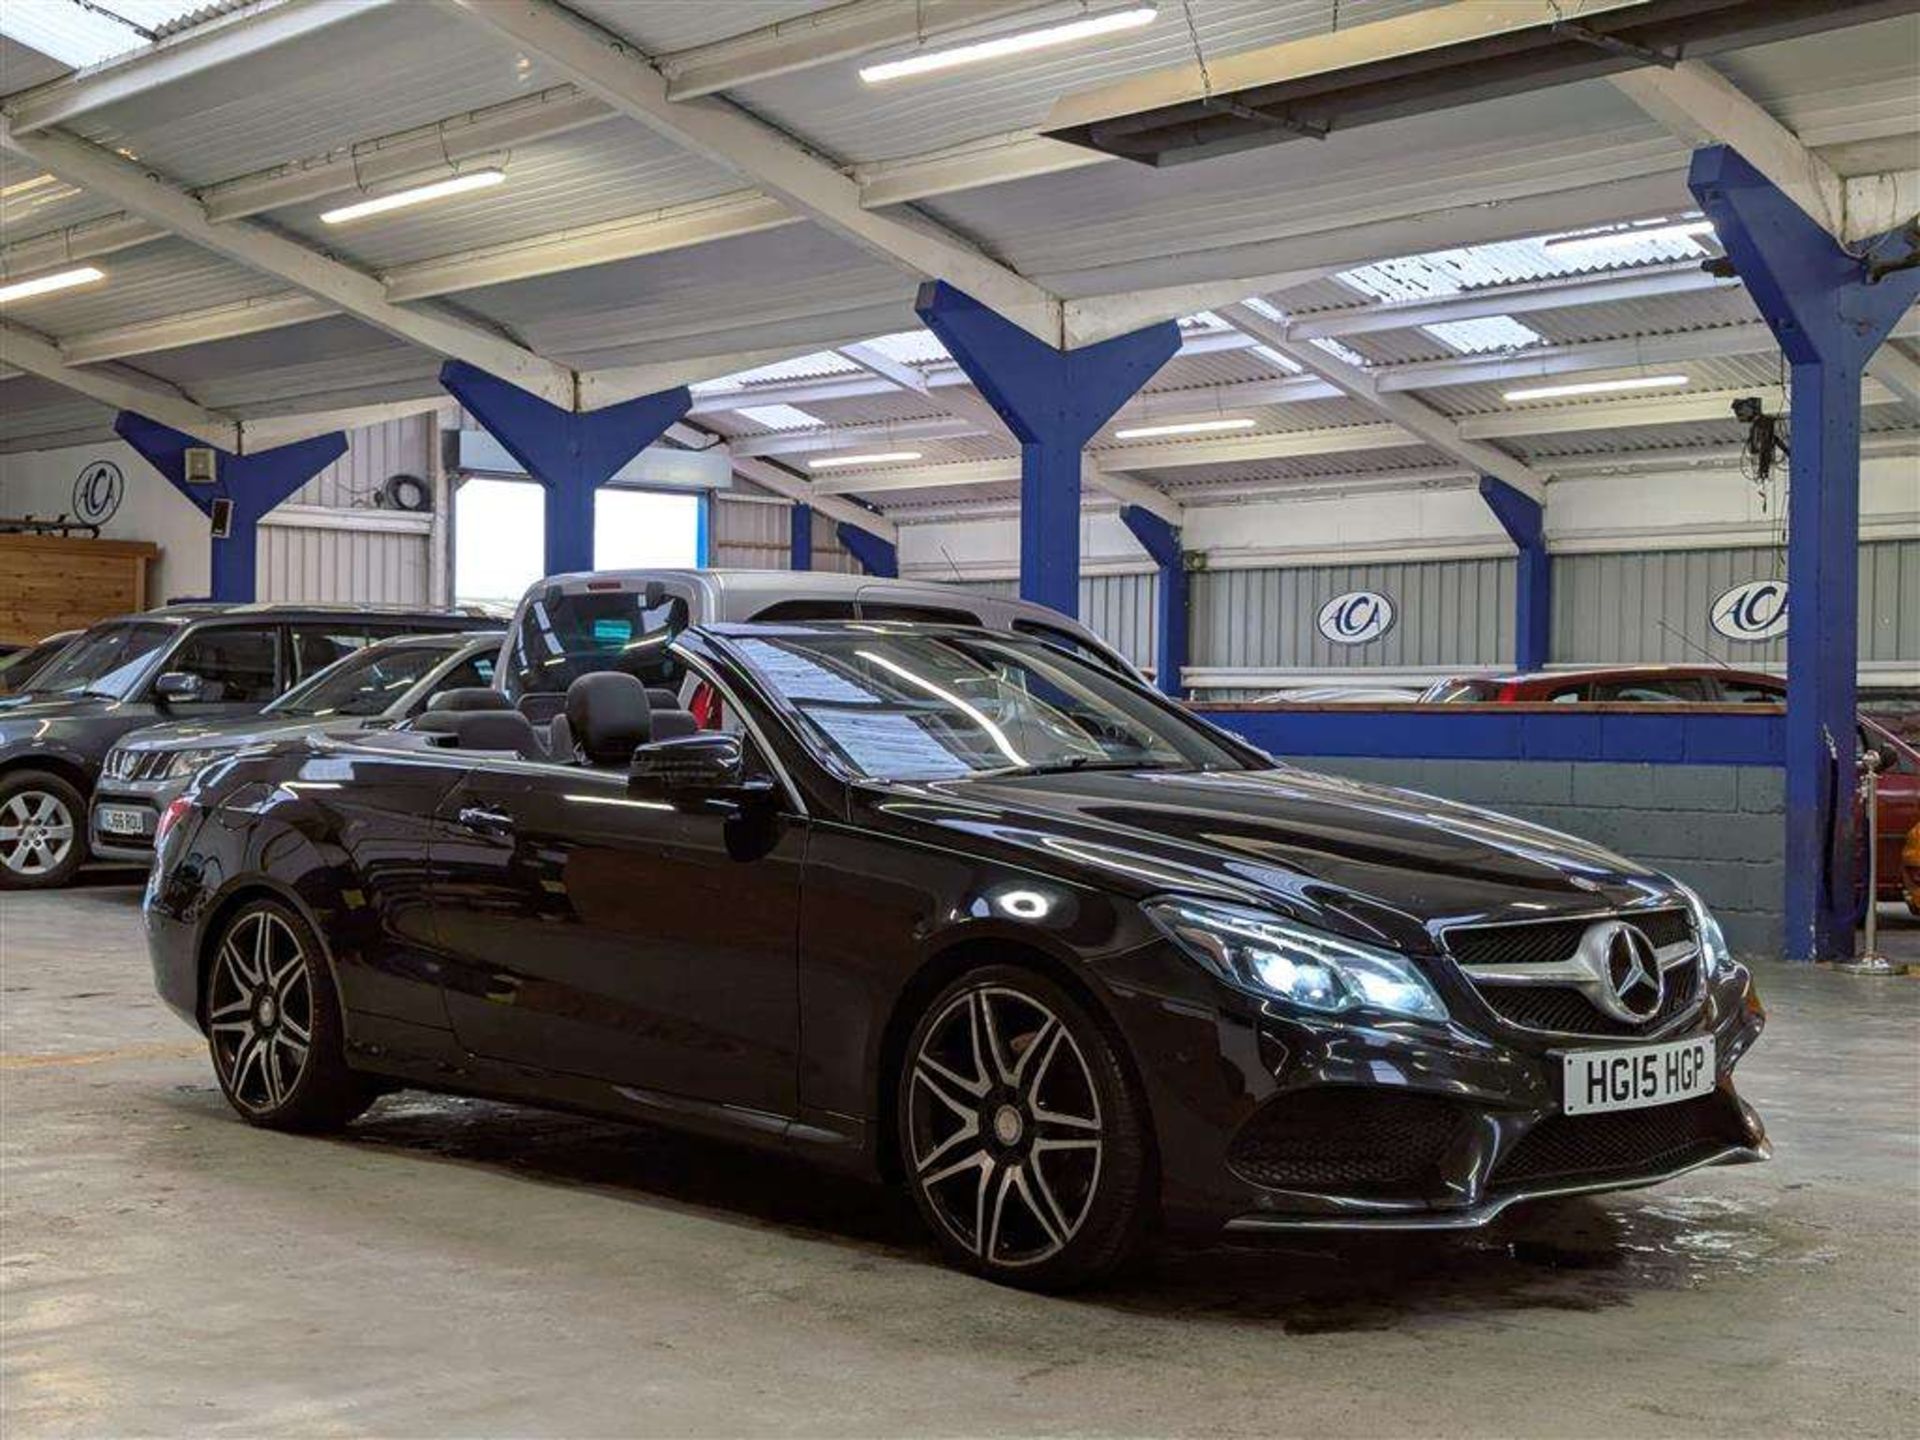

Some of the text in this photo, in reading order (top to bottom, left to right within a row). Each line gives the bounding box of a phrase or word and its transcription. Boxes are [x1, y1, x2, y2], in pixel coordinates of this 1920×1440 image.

[1321, 596, 1381, 637] ACA
[1587, 1046, 1704, 1104] HG15 HGP
